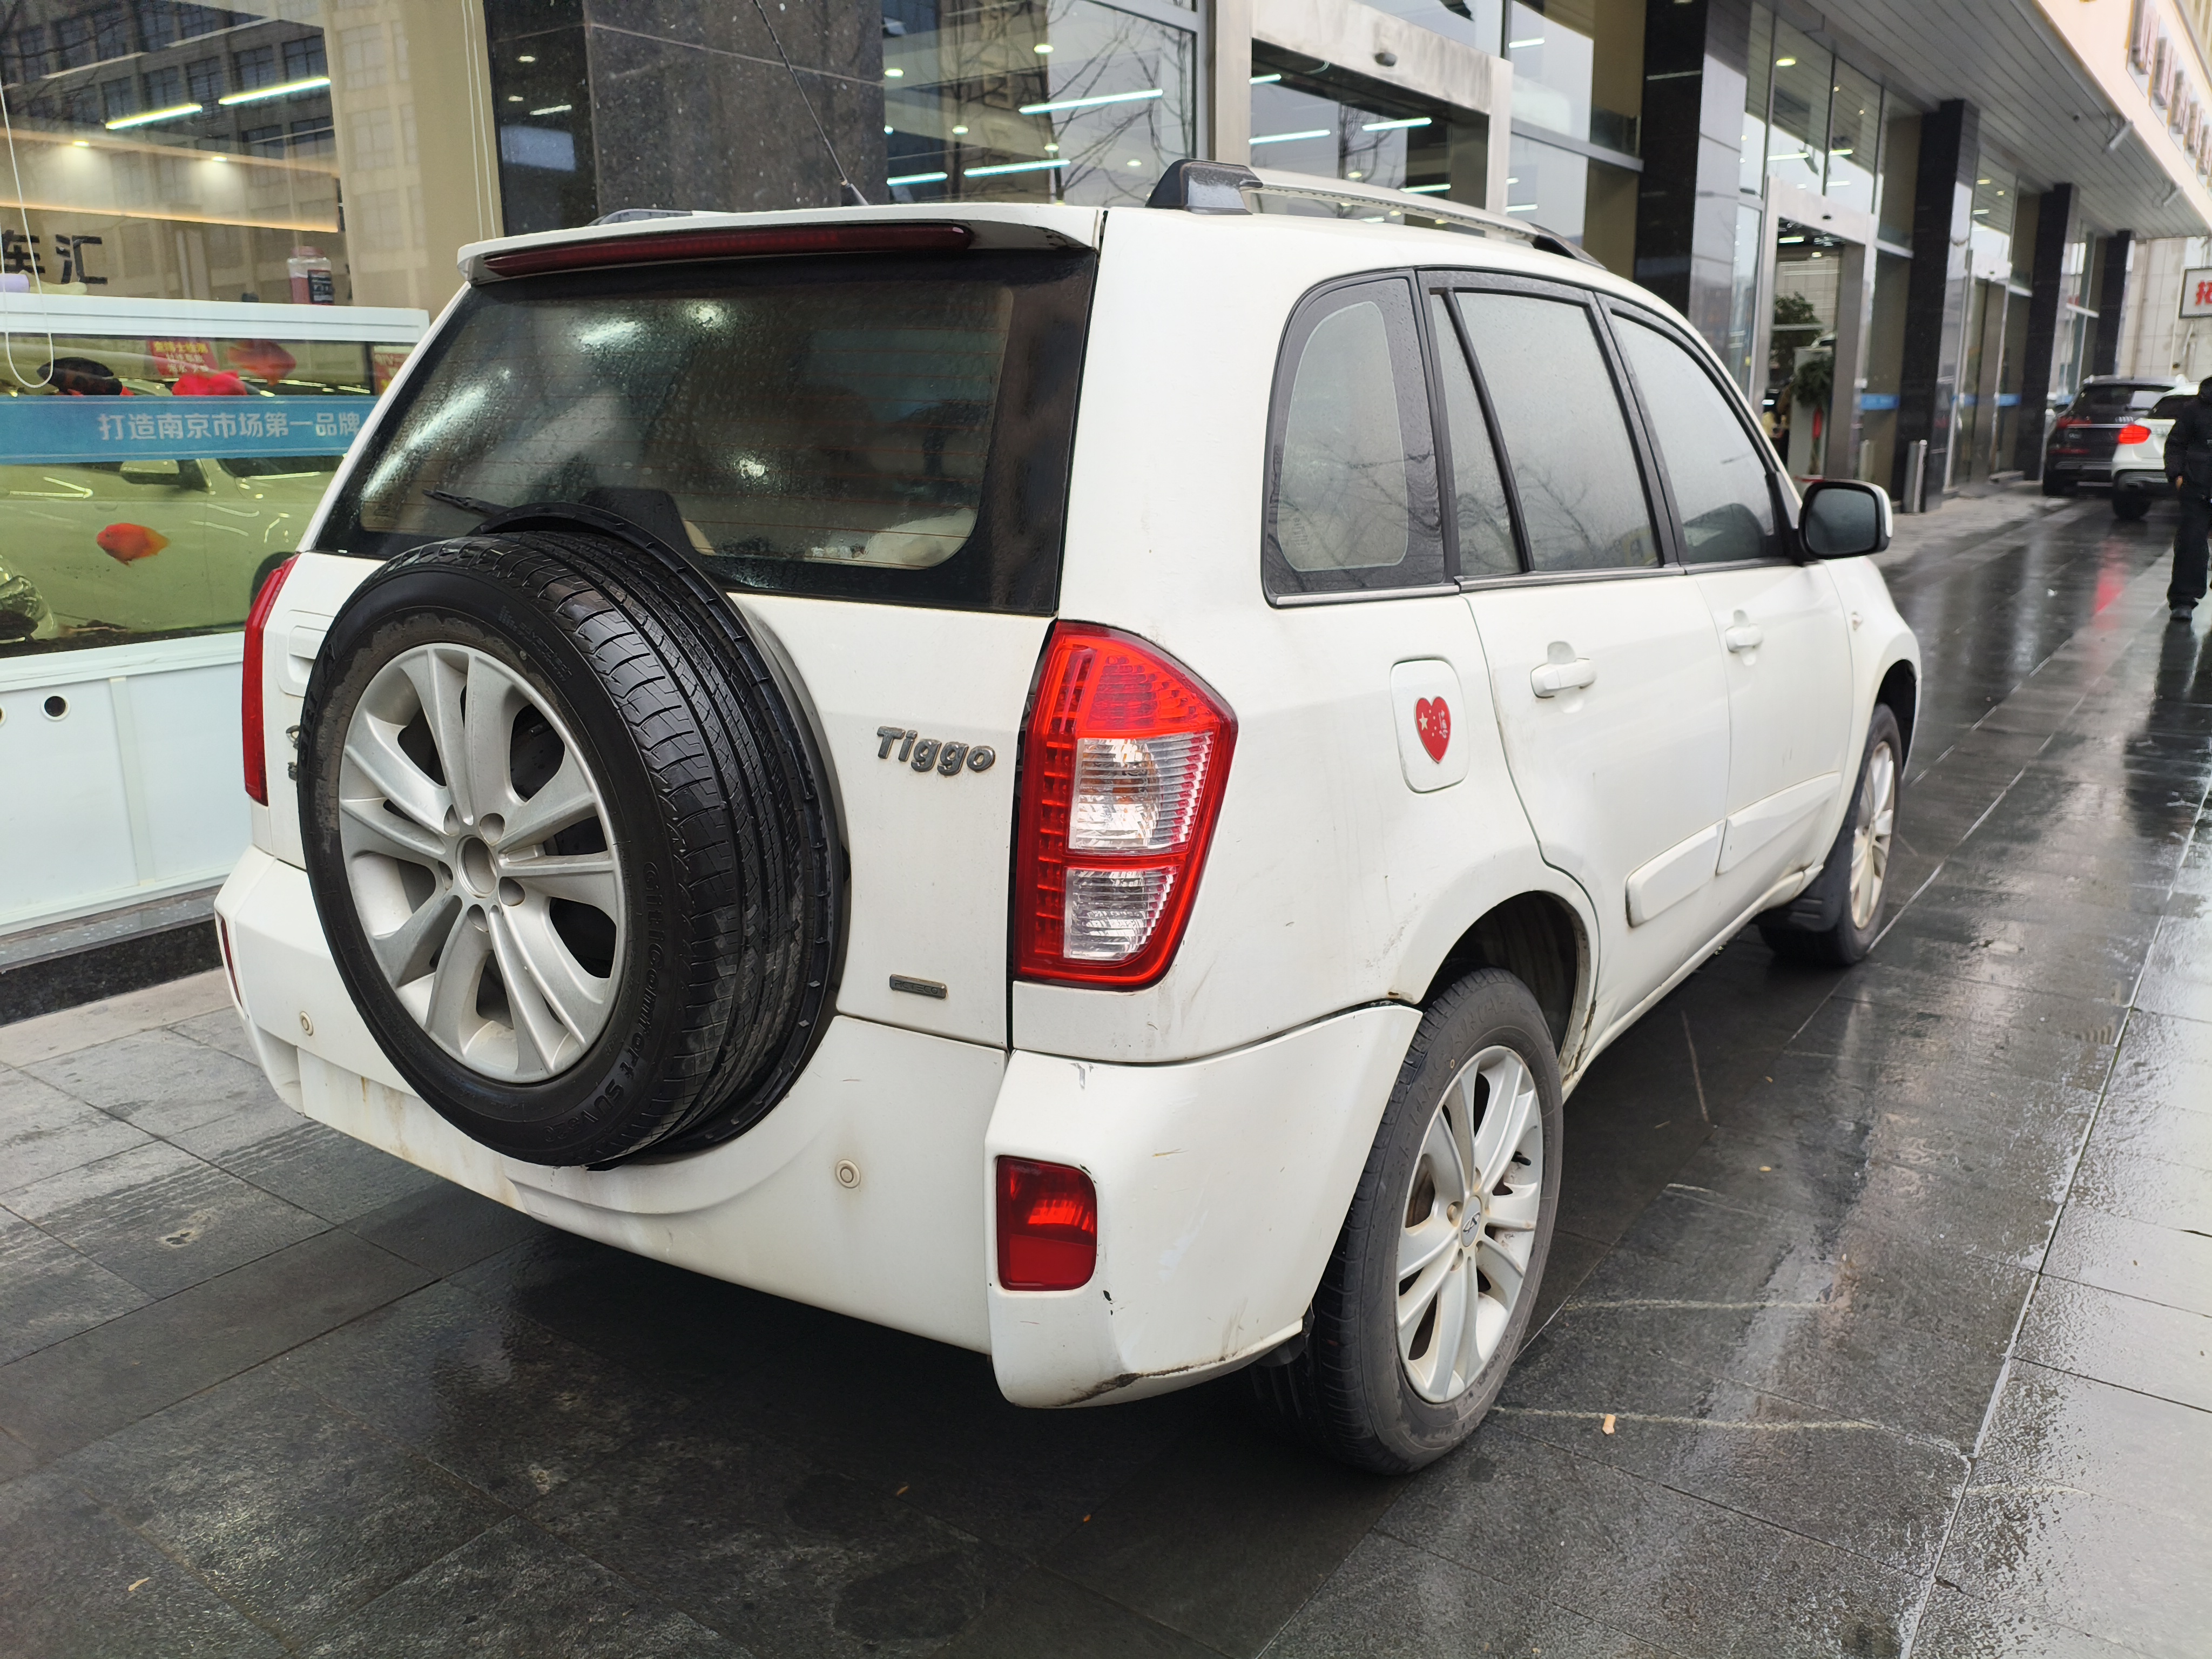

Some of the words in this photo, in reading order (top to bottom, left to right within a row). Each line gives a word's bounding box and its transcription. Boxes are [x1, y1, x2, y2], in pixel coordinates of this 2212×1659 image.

[98, 412, 361, 441] 打造南京市场第一品牌
[876, 726, 996, 777] Tiggo
